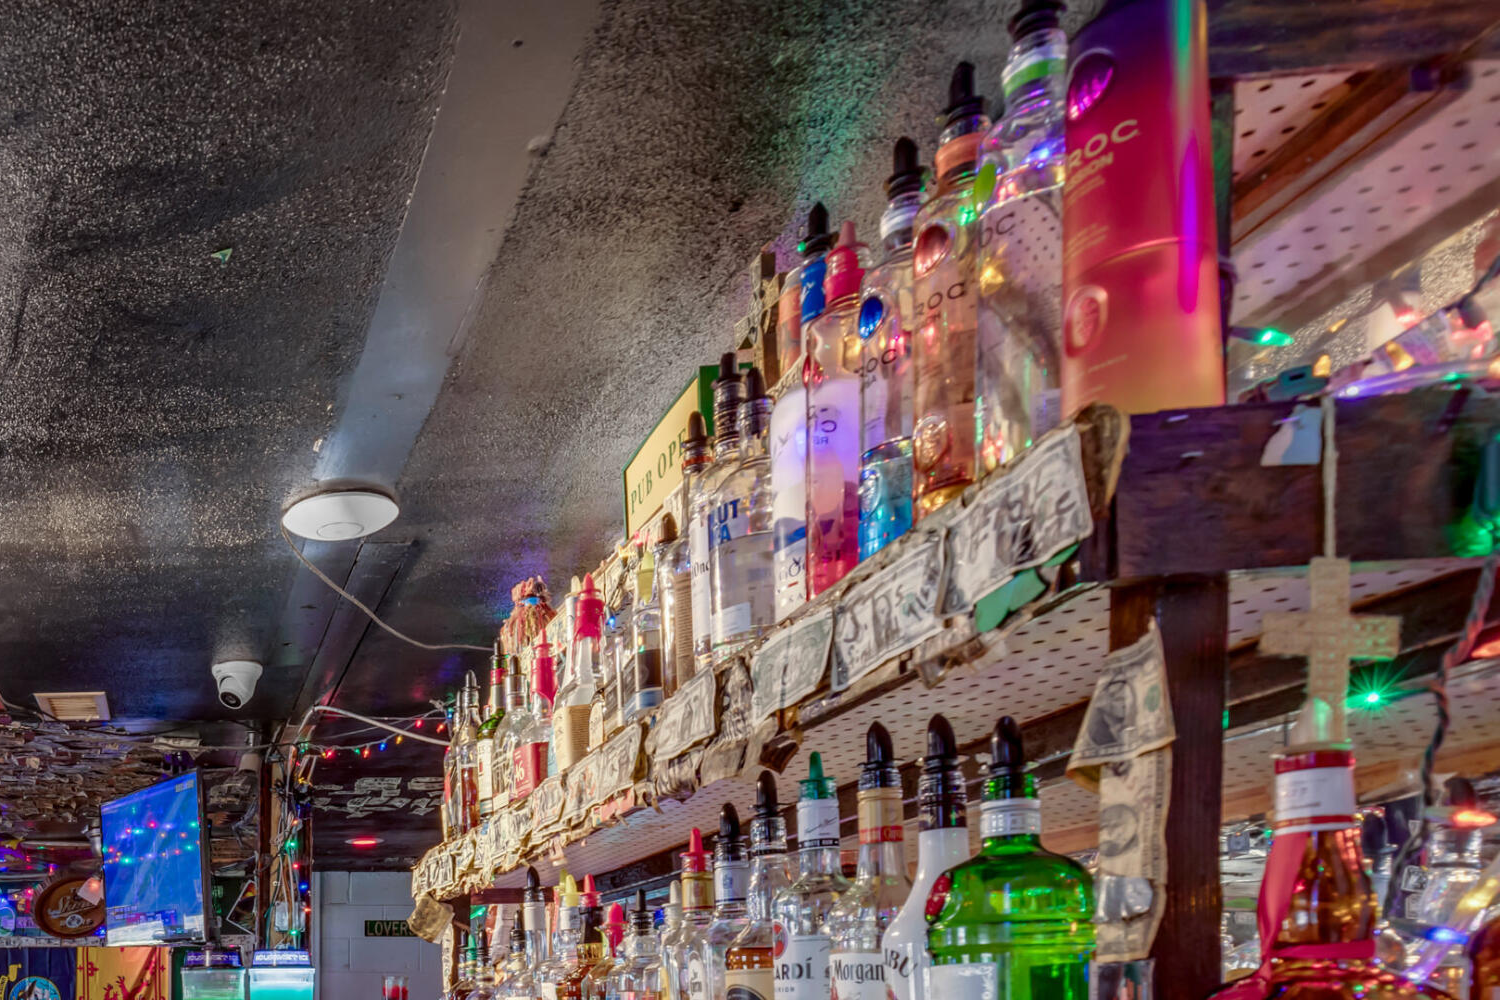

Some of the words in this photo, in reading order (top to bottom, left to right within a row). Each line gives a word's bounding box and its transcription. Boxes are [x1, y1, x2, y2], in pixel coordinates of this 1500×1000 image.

[1067, 119, 1138, 172] ROC
[630, 473, 653, 515] PUB
[775, 958, 814, 980] ARDÍ
[834, 960, 886, 984] Morgan
